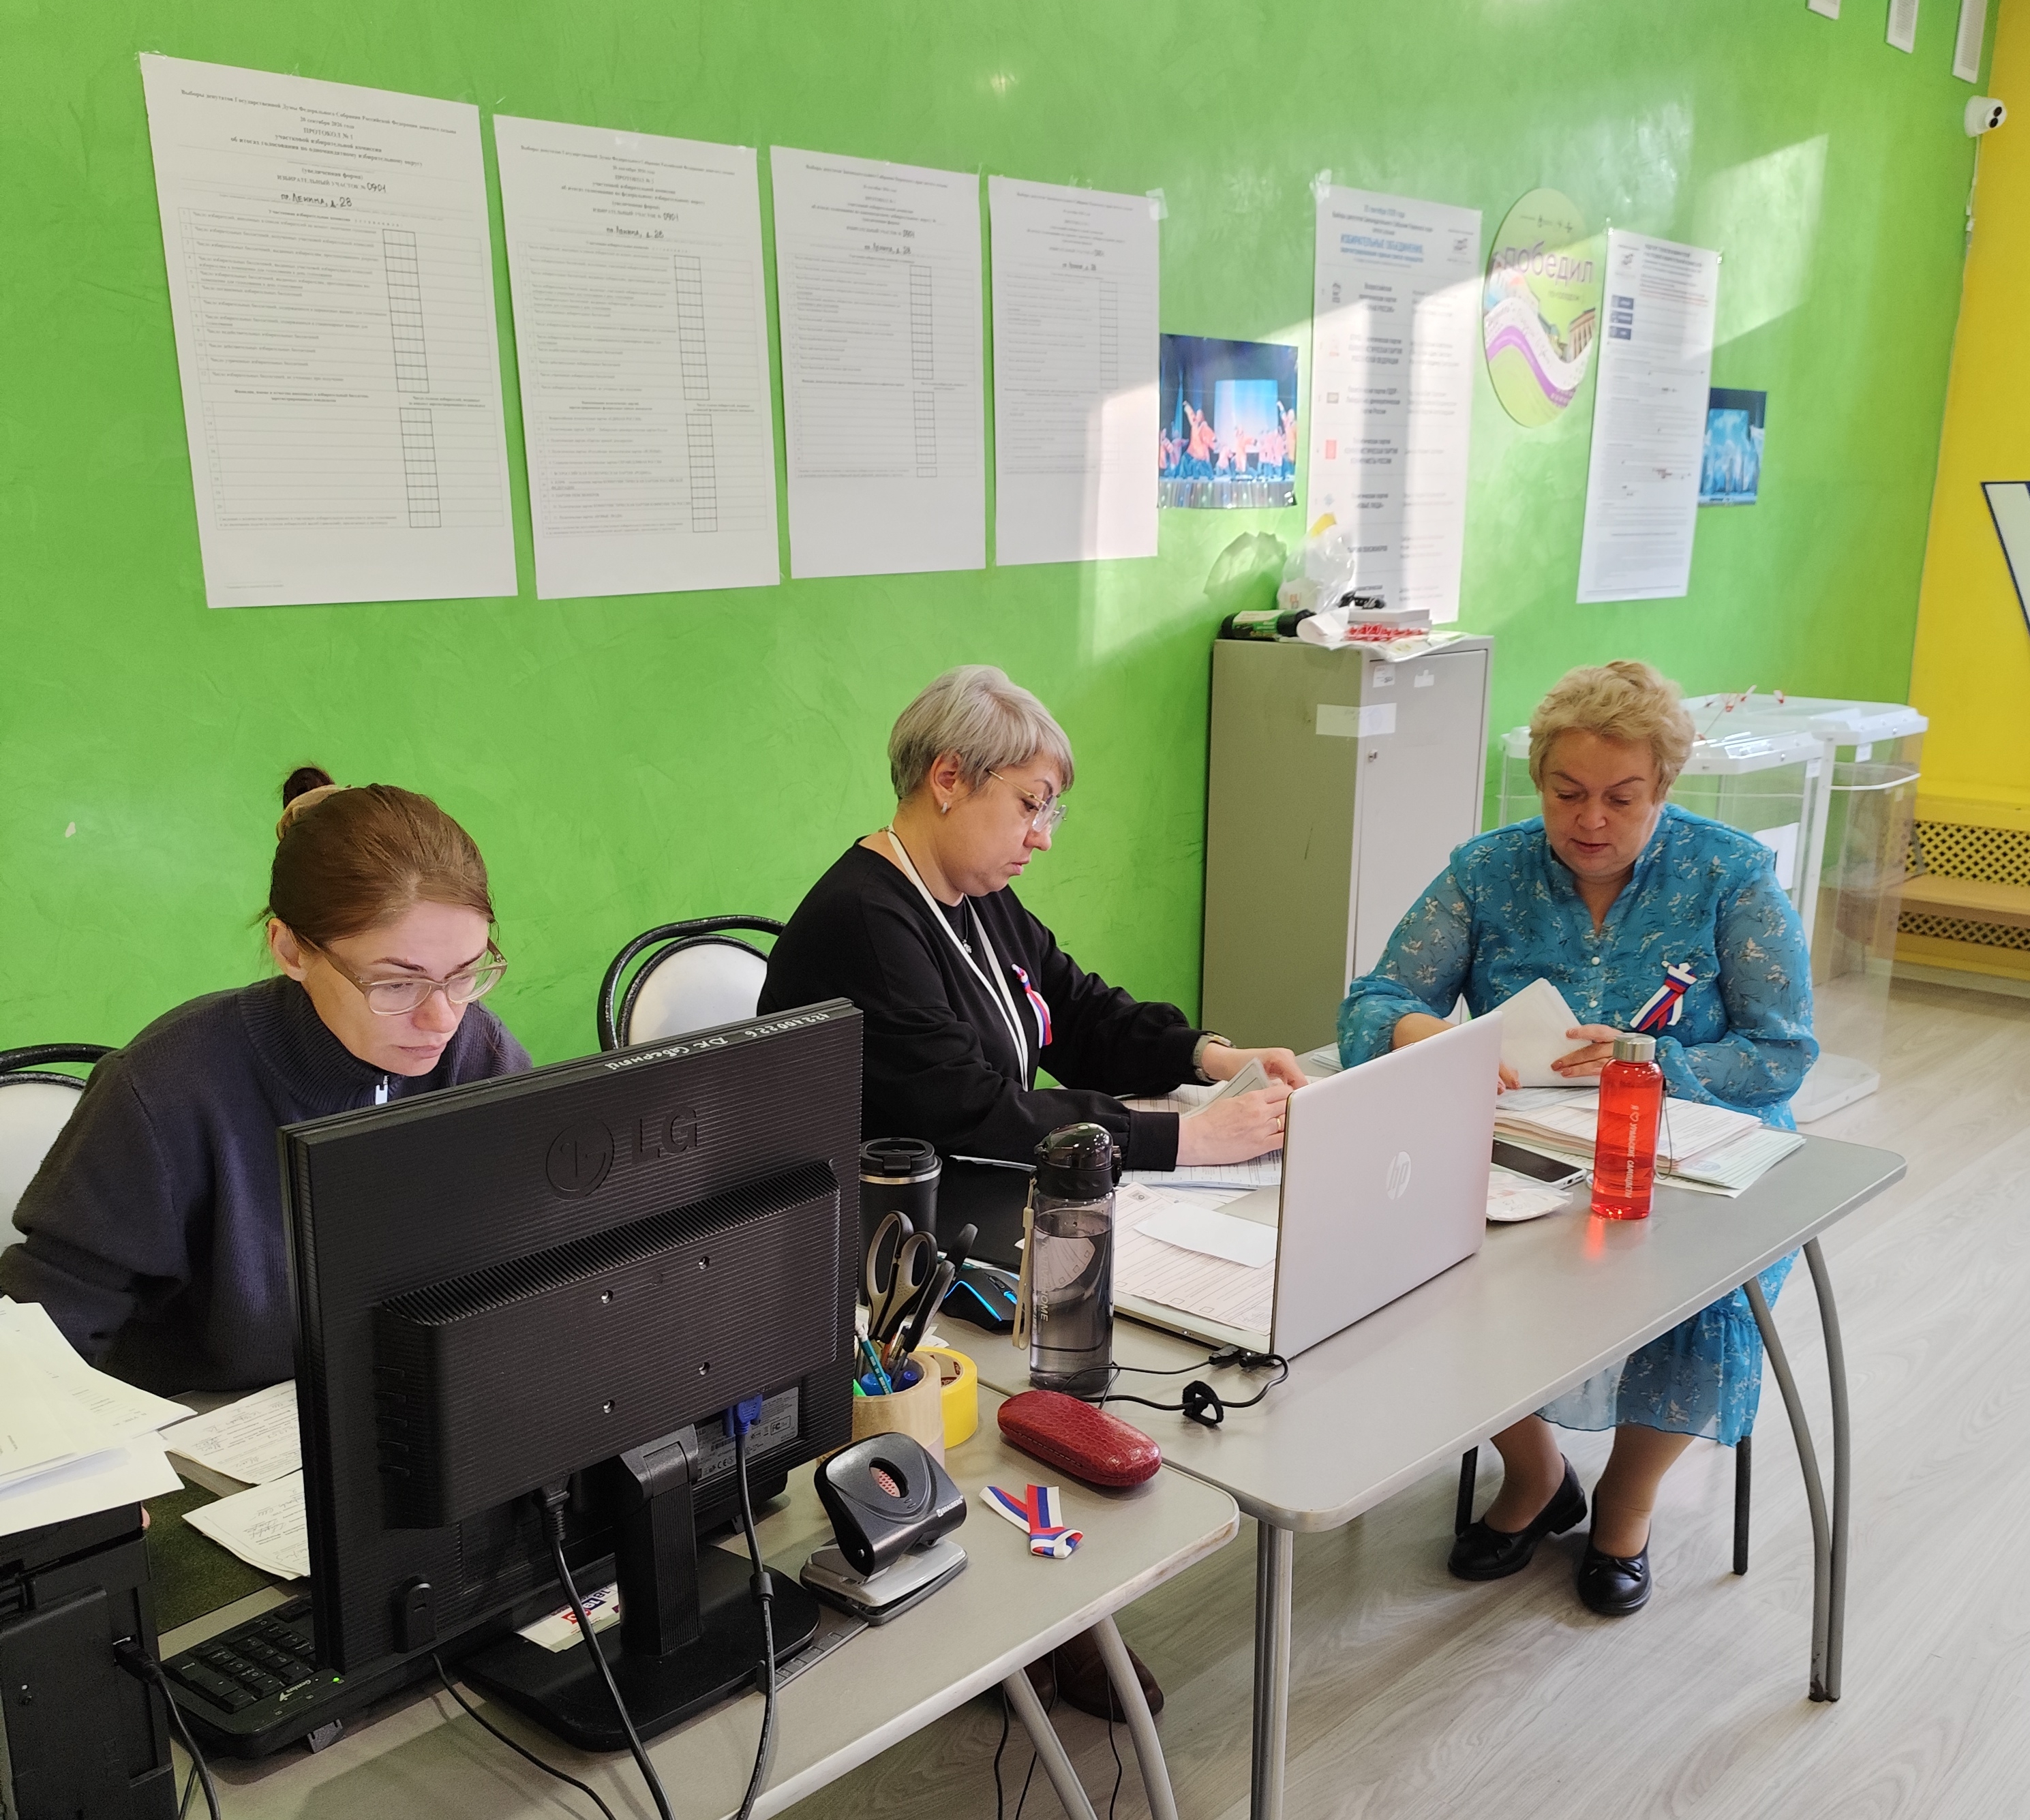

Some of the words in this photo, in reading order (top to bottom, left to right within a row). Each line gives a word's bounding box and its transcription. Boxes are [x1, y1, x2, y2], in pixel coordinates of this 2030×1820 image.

[631, 1106, 697, 1164] LG
[1387, 1151, 1411, 1200] hp
[1040, 1286, 1049, 1322] HOME
[583, 1600, 601, 1609] 19
[593, 1588, 611, 1598] 18
